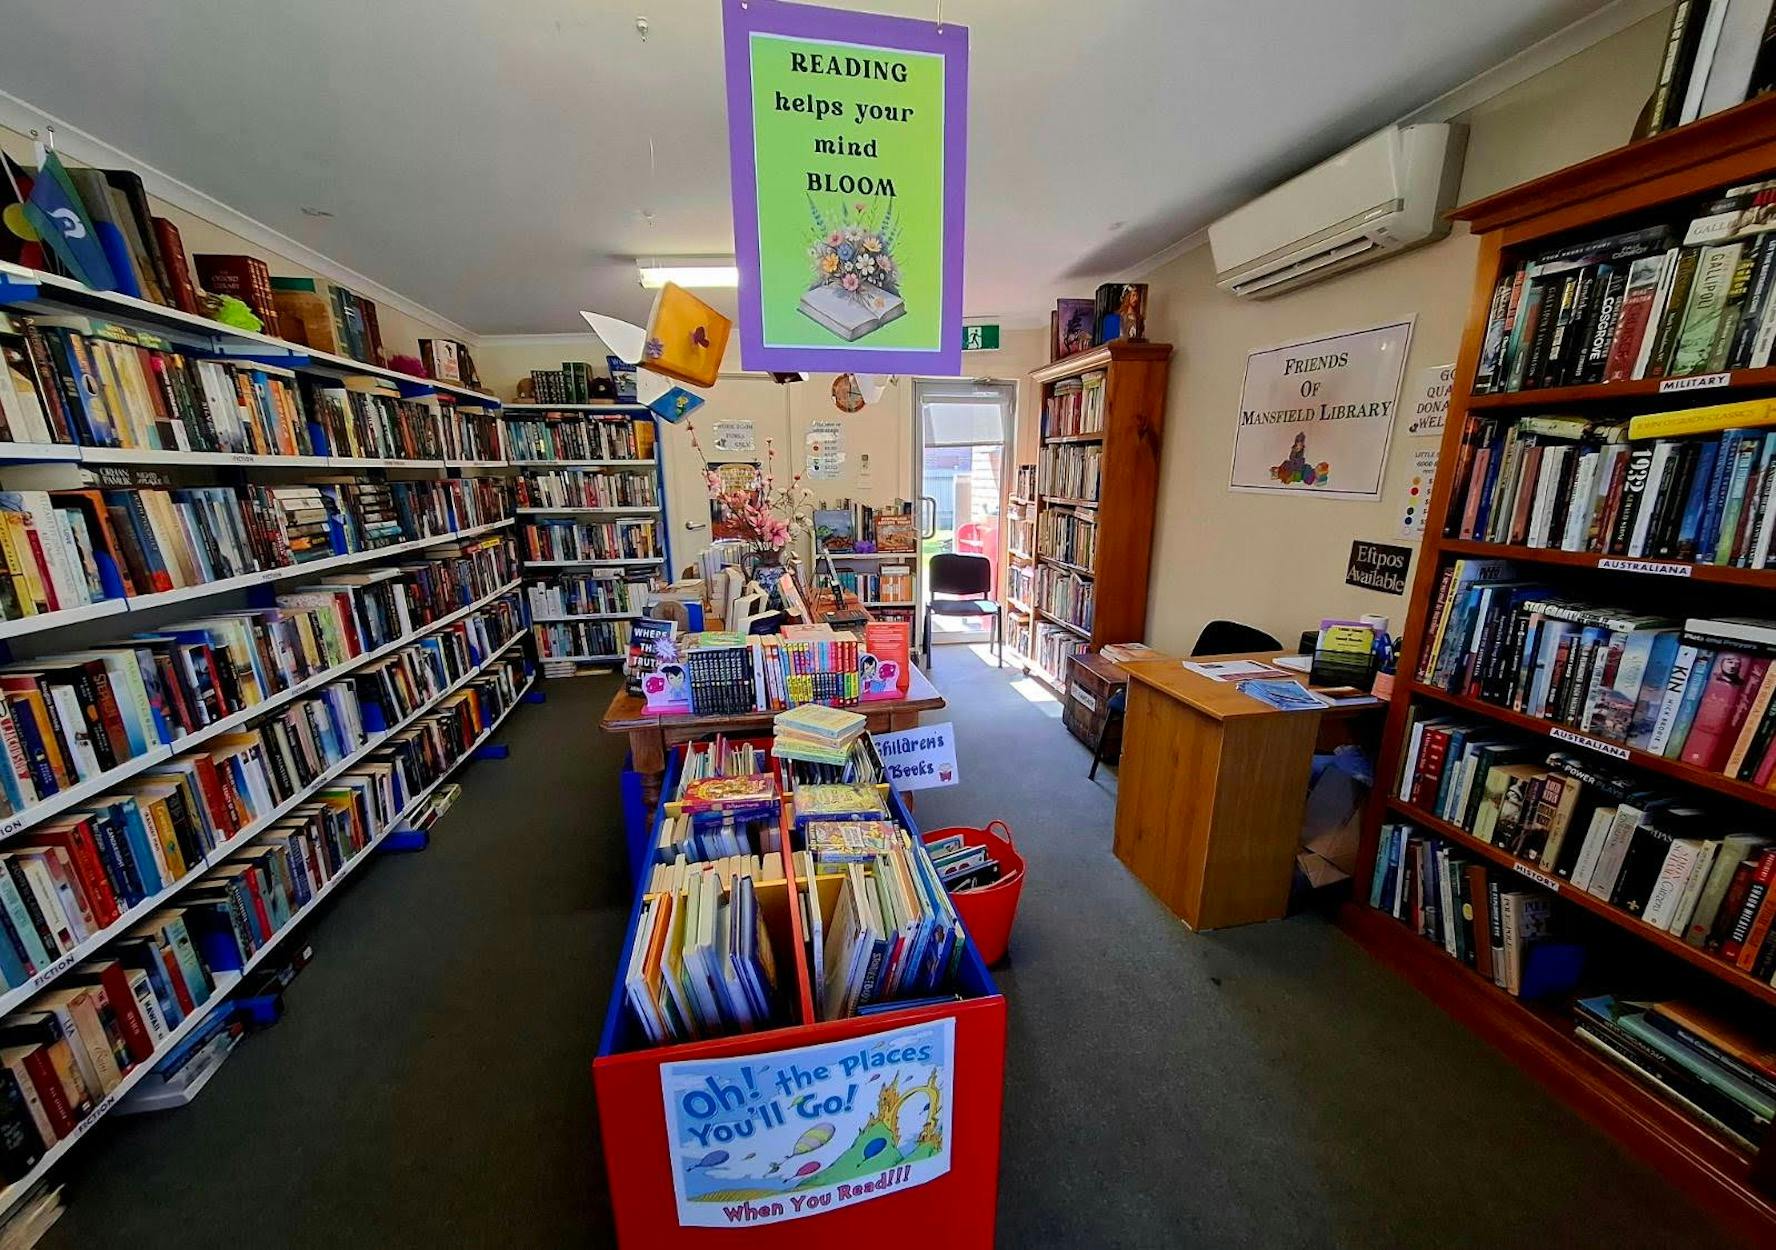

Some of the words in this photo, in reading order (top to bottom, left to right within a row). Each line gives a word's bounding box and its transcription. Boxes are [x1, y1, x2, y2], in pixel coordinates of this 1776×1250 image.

[790, 51, 908, 83] READING
[775, 91, 844, 120] helps
[855, 103, 915, 124] your
[814, 136, 878, 158] mind
[807, 172, 897, 197] BLOOM
[1697, 253, 1724, 310] GALLIPOLI
[1589, 296, 1615, 361] COSGROVE
[1284, 353, 1349, 375] FRIENDS
[1301, 380, 1321, 397] OF
[1663, 376, 1727, 391] MILITARY
[1241, 408, 1315, 425] MANSFIELD
[1319, 401, 1392, 421] LIBRARY
[1626, 449, 1652, 492] 1932
[1357, 545, 1405, 569] Eftpos
[1603, 560, 1689, 576] AUSTRALIANA
[1347, 566, 1405, 593] Available
[1669, 664, 1688, 694] KIN
[1553, 728, 1628, 759] AUSTRALIANA
[888, 761, 934, 779] Books
[1564, 764, 1596, 785] POWER
[1515, 864, 1557, 890] HISTORY
[34, 956, 75, 986] FICTION
[681, 1066, 758, 1120] Oh!
[775, 1065, 829, 1098] the
[839, 1044, 933, 1078] Places
[78, 1097, 115, 1133] FICTION
[688, 1104, 784, 1148] You'll
[795, 1084, 859, 1120] Go!
[724, 1201, 784, 1223] When
[791, 1190, 832, 1214] You
[837, 1165, 912, 1199] Read!!!
